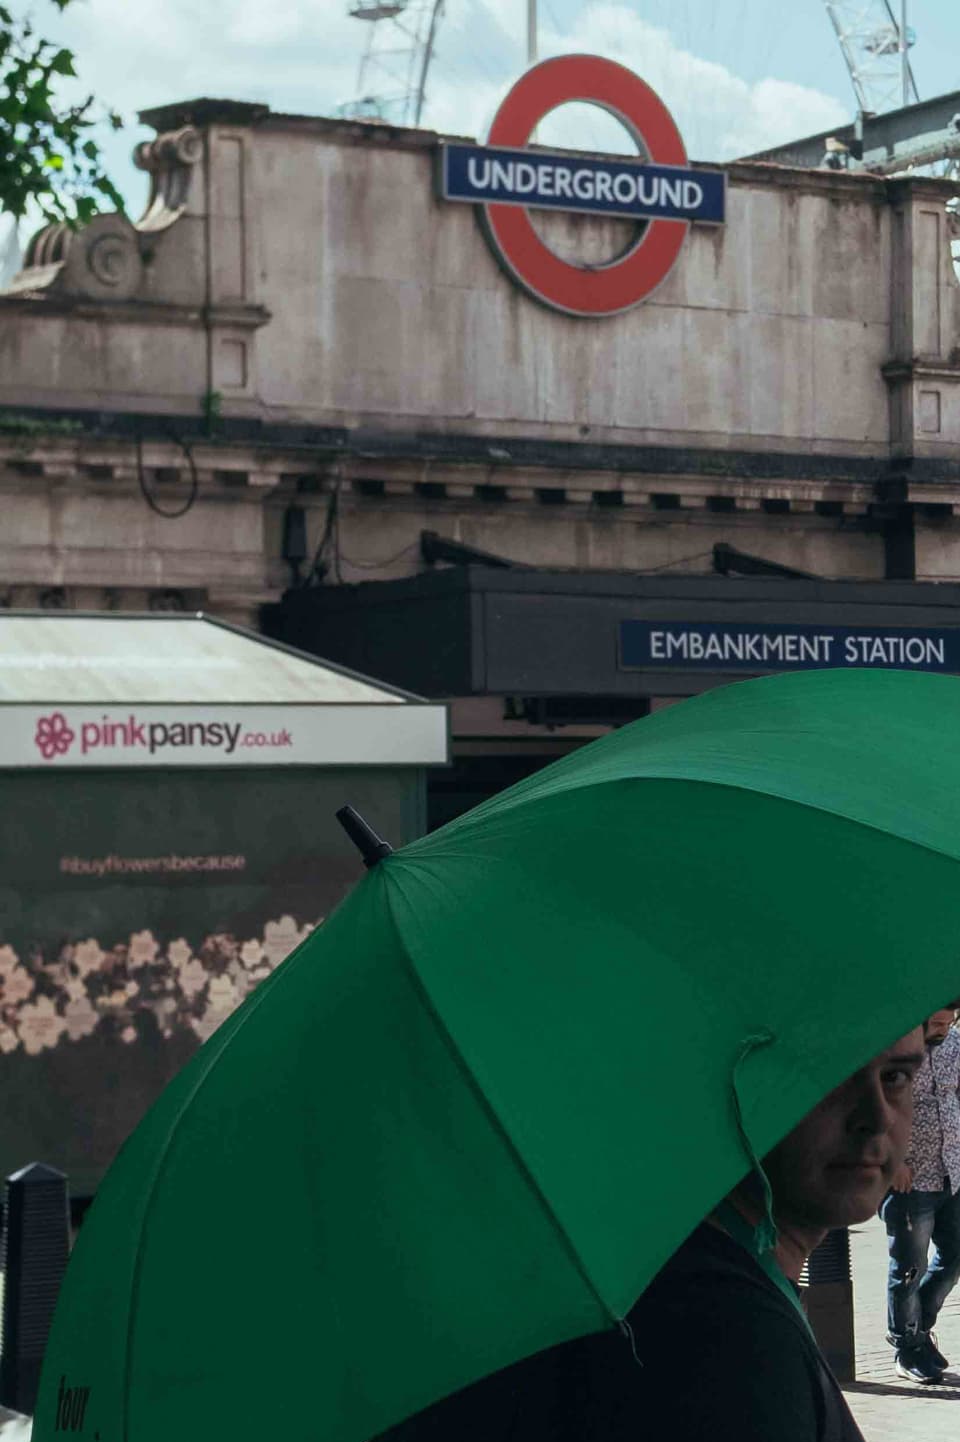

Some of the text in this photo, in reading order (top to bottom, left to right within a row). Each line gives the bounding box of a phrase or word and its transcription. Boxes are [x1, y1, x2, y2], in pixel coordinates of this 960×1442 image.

[467, 156, 704, 211] UNDERGROUND
[649, 630, 946, 665] EMBANKMENT STATION
[80, 713, 293, 754] pinkpansy.co.uk
